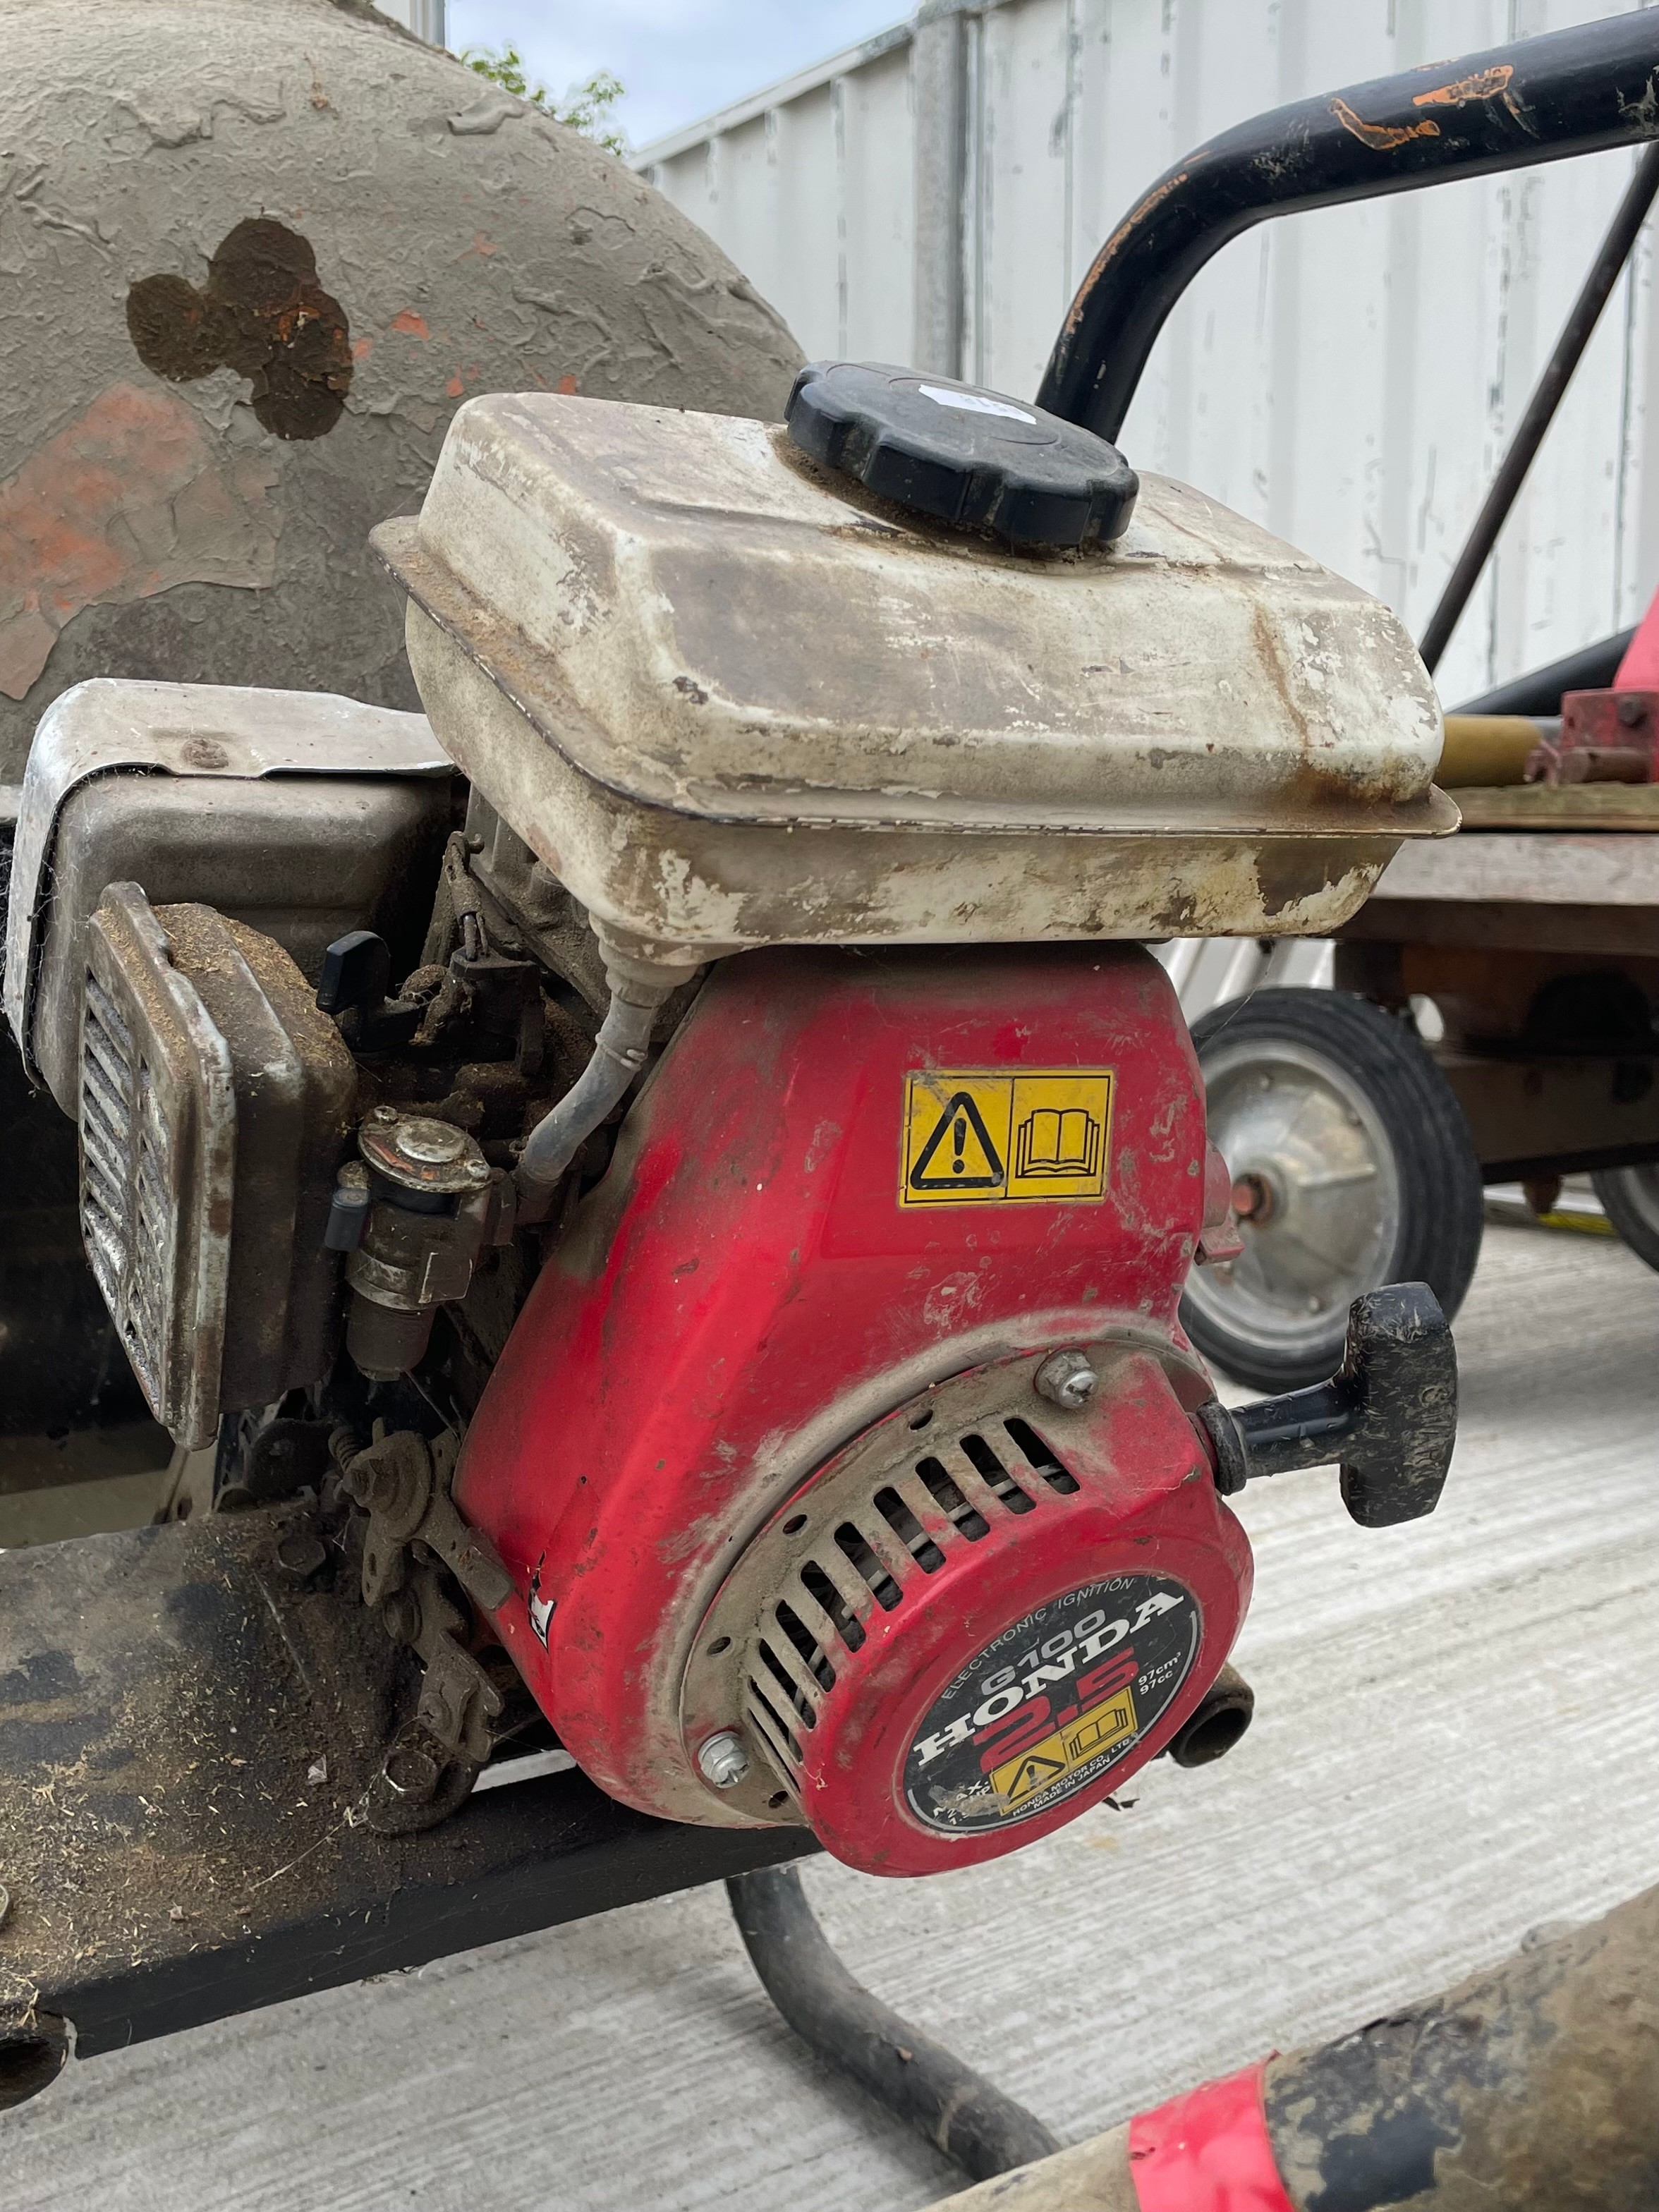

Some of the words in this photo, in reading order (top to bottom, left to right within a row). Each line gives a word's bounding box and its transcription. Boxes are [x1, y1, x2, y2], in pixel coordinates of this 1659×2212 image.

[913, 1591, 1184, 1766] HONDA
[942, 1608, 1047, 1700] ELECTRONIC
[1058, 1577, 1135, 1608] IGNITION
[980, 1609, 1106, 1696] G100
[973, 1647, 1139, 1774] 2.5
[1140, 1670, 1173, 1696] 97cc
[1013, 1790, 1050, 1816] HONDA
[1051, 1766, 1088, 1792] MOTOR
[1111, 1737, 1134, 1754] LTD.
[1033, 1788, 1063, 1809] MADE
[1065, 1779, 1076, 1789] IN
[1078, 1756, 1111, 1780] JAPAN
